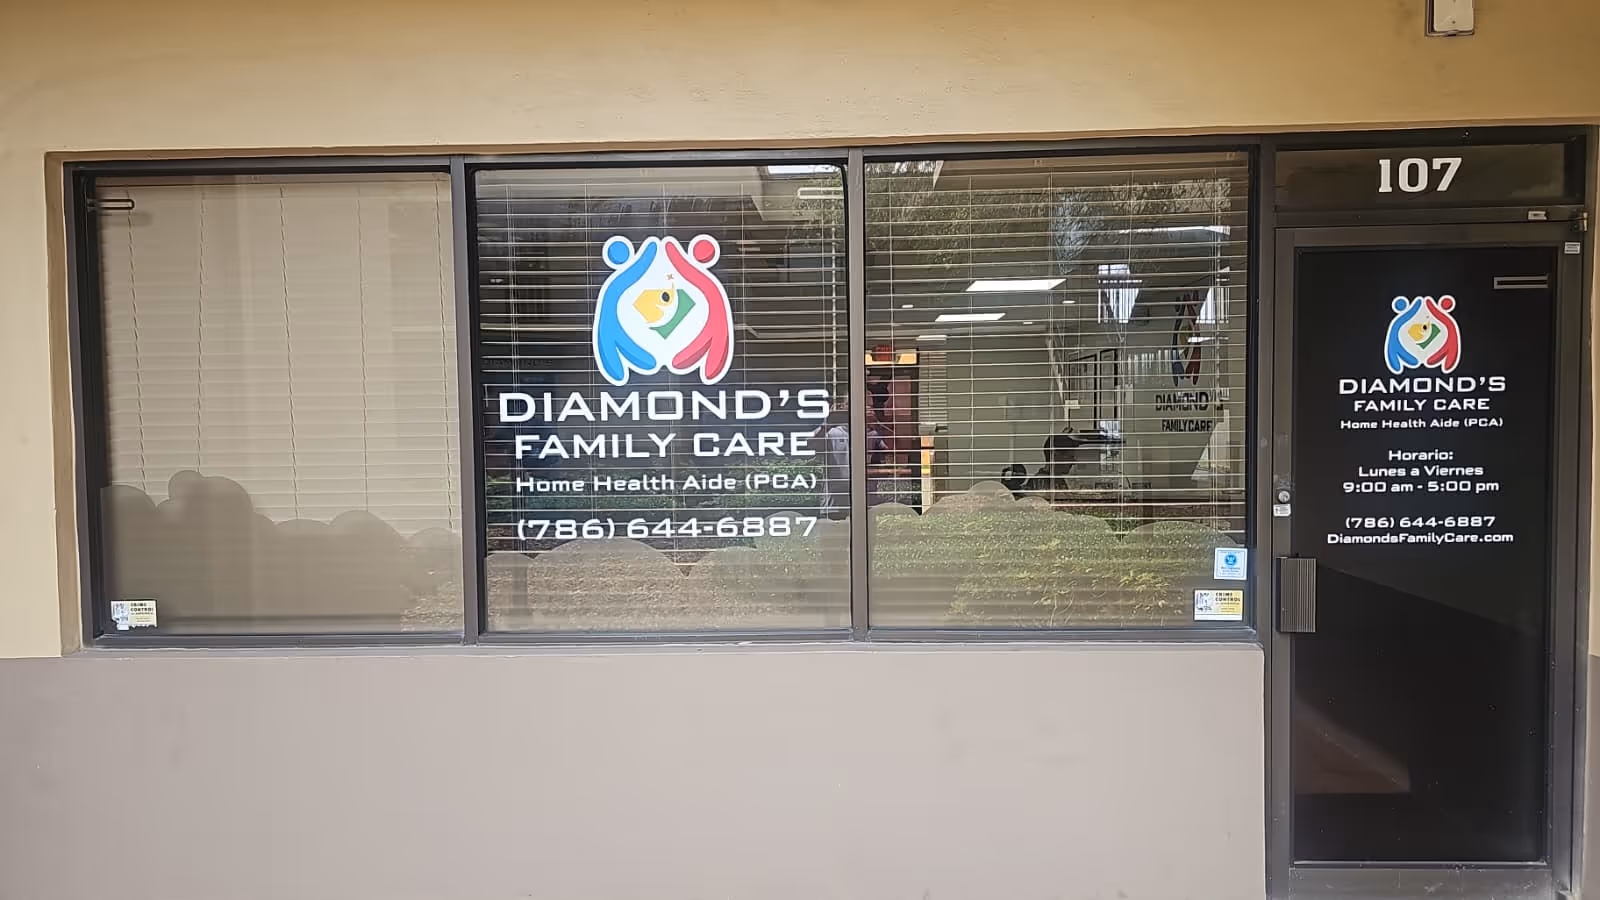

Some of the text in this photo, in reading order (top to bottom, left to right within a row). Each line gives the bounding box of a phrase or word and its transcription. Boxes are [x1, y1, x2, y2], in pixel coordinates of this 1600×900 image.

[1378, 157, 1462, 193] 107
[1339, 376, 1506, 394] DIAMOND'S
[499, 389, 830, 423] DIAMOND'S
[1354, 398, 1490, 412] FAMILY CARE
[1340, 417, 1504, 429] Home Health Aide (PCA)
[515, 431, 816, 460] FAMILY CARE
[1388, 449, 1454, 461] Horario:
[1358, 465, 1484, 477] Lunes a Viernes
[516, 473, 818, 492] Home Health Aide (PCA)
[1343, 481, 1387, 493] 9:00
[1391, 483, 1414, 492] am
[1427, 480, 1472, 492] 5:00
[1475, 482, 1500, 494] pm
[517, 516, 819, 541] (786) 644-6887
[1345, 515, 1497, 529] (786) 644-6887
[1327, 532, 1514, 545] DiamondsFamilyCare.com
